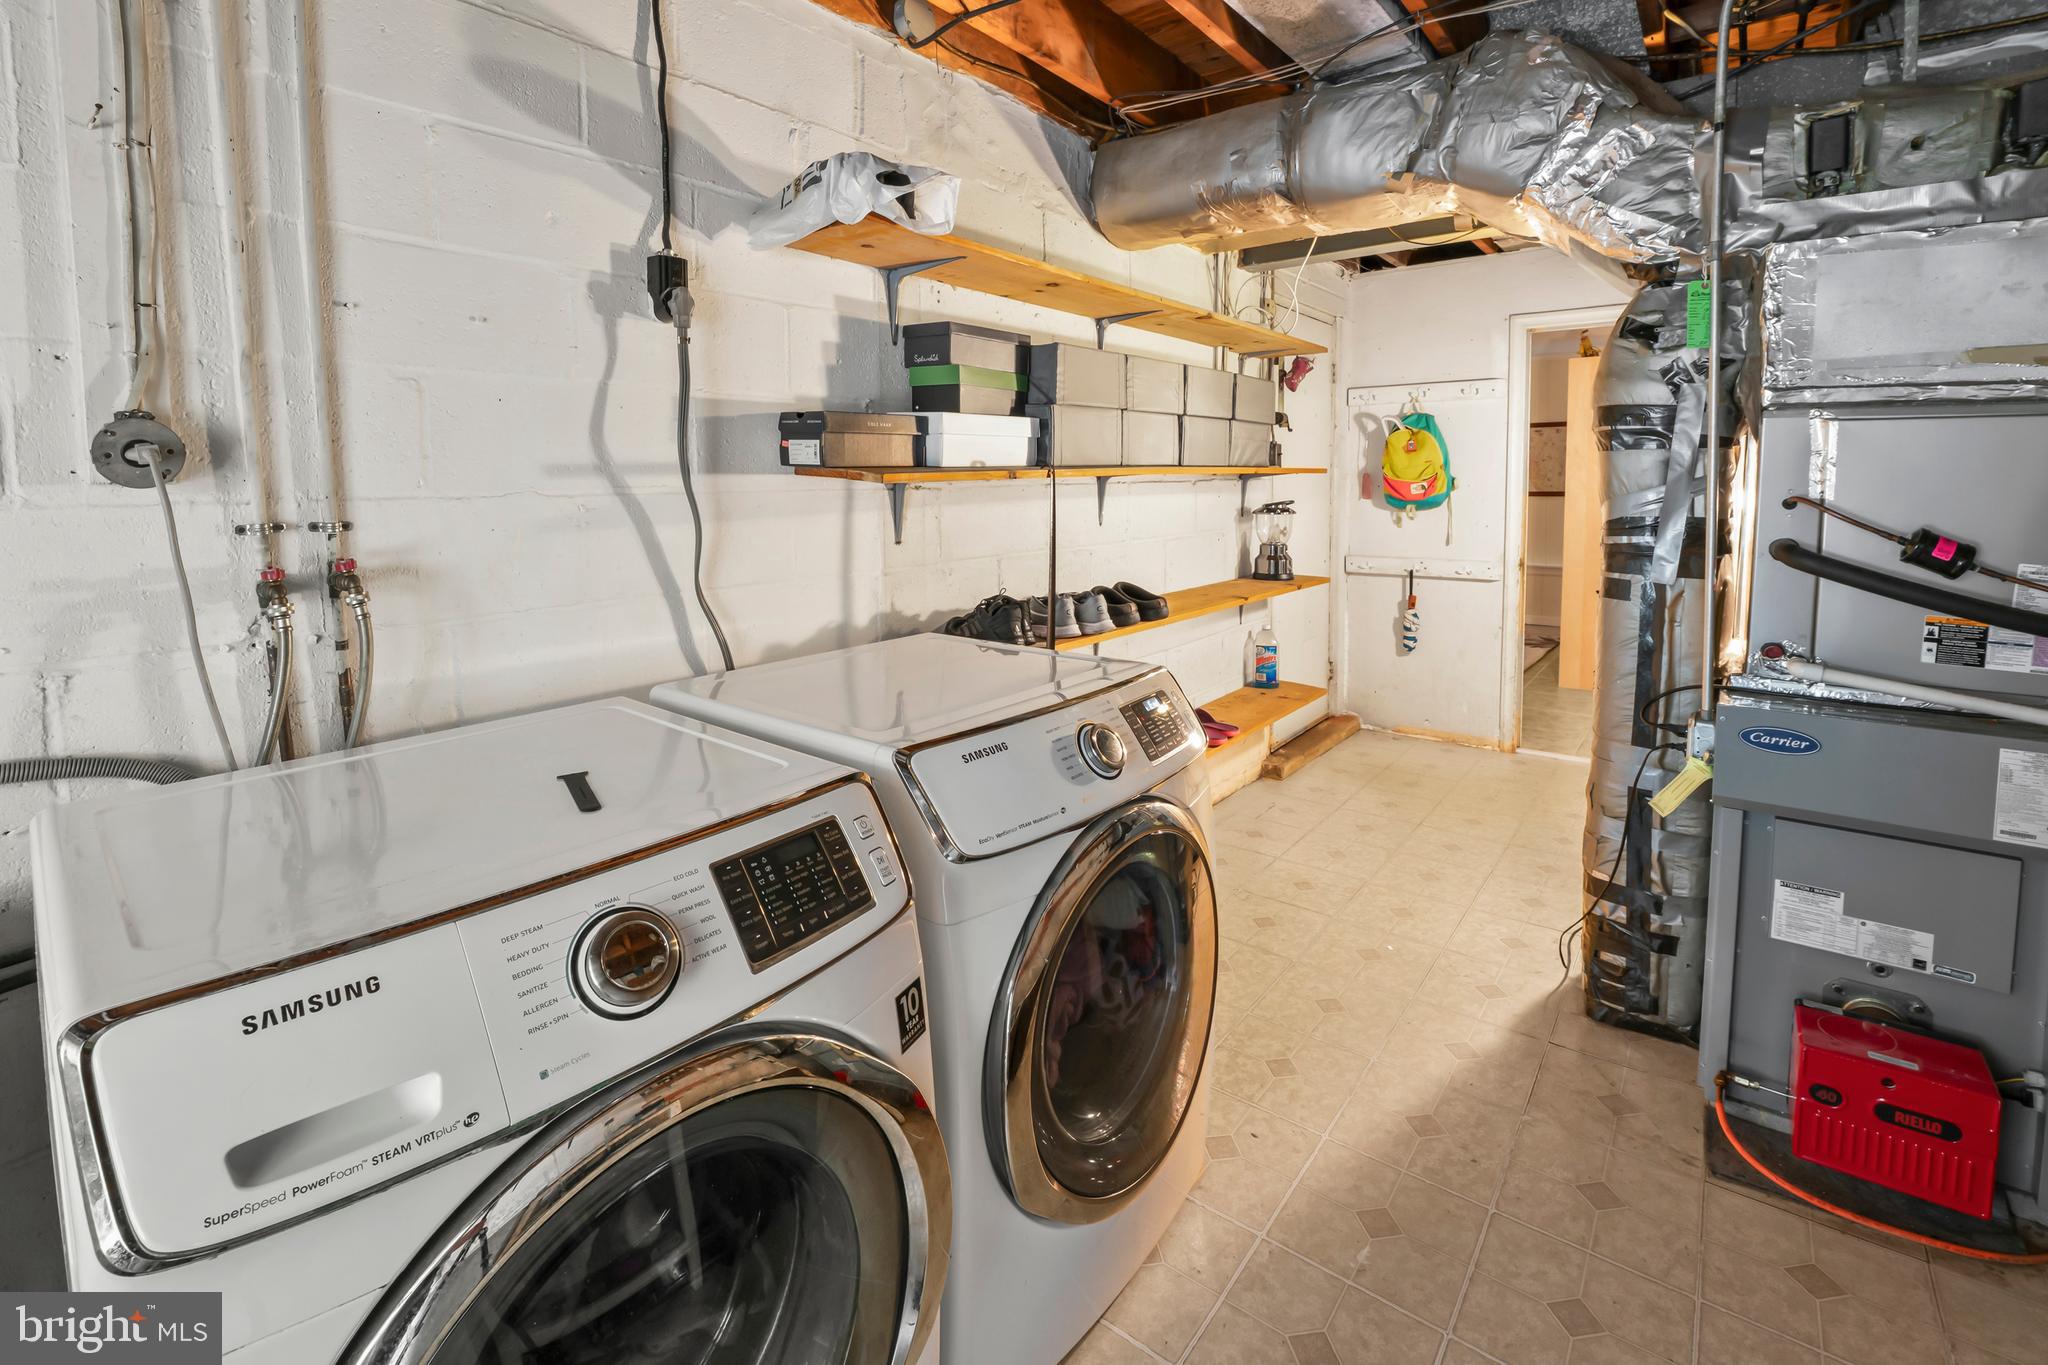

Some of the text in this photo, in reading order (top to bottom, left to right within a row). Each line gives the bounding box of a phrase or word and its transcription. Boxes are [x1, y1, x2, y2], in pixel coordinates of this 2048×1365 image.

[1750, 732, 1810, 749] Carrier
[961, 742, 1009, 764] SAMSUNG
[673, 868, 699, 882] ECO COLD
[671, 884, 706, 901] QUICK WASH
[1780, 880, 1809, 892] ATTENTION
[594, 895, 621, 909] NORMAL
[678, 898, 711, 915] PERM PRESS
[700, 914, 717, 924] WOOL
[500, 923, 544, 945] DEEP STEAM
[694, 929, 722, 945] DELICATES
[507, 942, 550, 964] HEAVY DUTY
[691, 943, 728, 963] ACTIVE WEAR
[512, 963, 544, 981] BEDDING
[517, 982, 549, 999] SANITIZE
[241, 975, 381, 1036] SAMSUNG
[523, 997, 559, 1017] ALLERGEN
[899, 986, 920, 1023] 10
[901, 1018, 925, 1045] WARRANTY
[906, 1013, 919, 1032] YEAR
[1815, 1088, 1837, 1103] 40
[1894, 1110, 1943, 1135] RIELLO
[203, 1190, 287, 1229] SuperSpeed
[371, 1141, 412, 1166] STEAM
